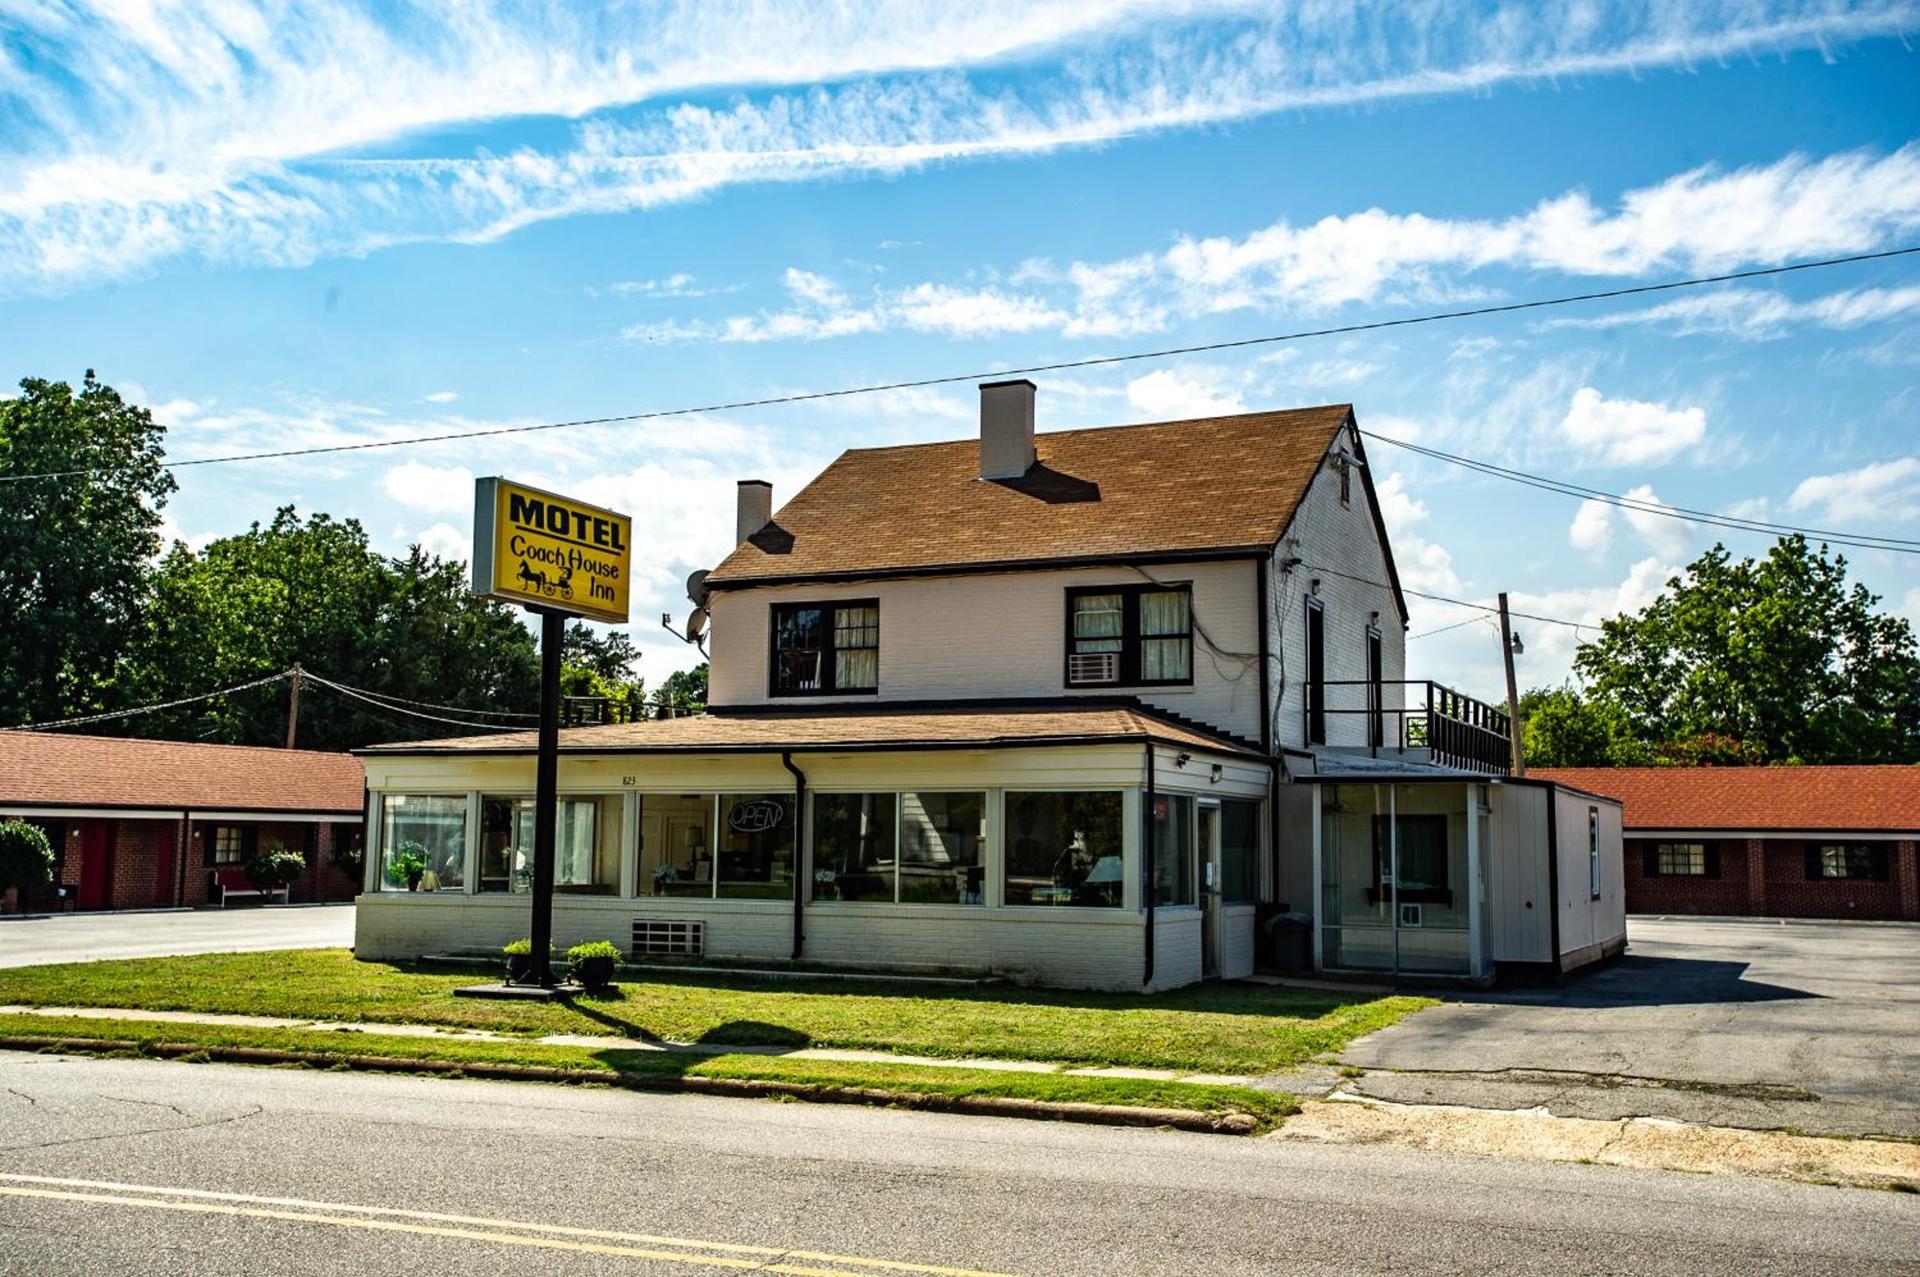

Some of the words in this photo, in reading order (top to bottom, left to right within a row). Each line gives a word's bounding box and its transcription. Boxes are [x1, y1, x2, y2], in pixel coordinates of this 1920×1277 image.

[510, 493, 625, 551] MOTEL
[510, 535, 566, 566] Coach
[568, 548, 619, 579] House
[590, 576, 615, 601] Inn
[731, 805, 779, 827] OPEN
